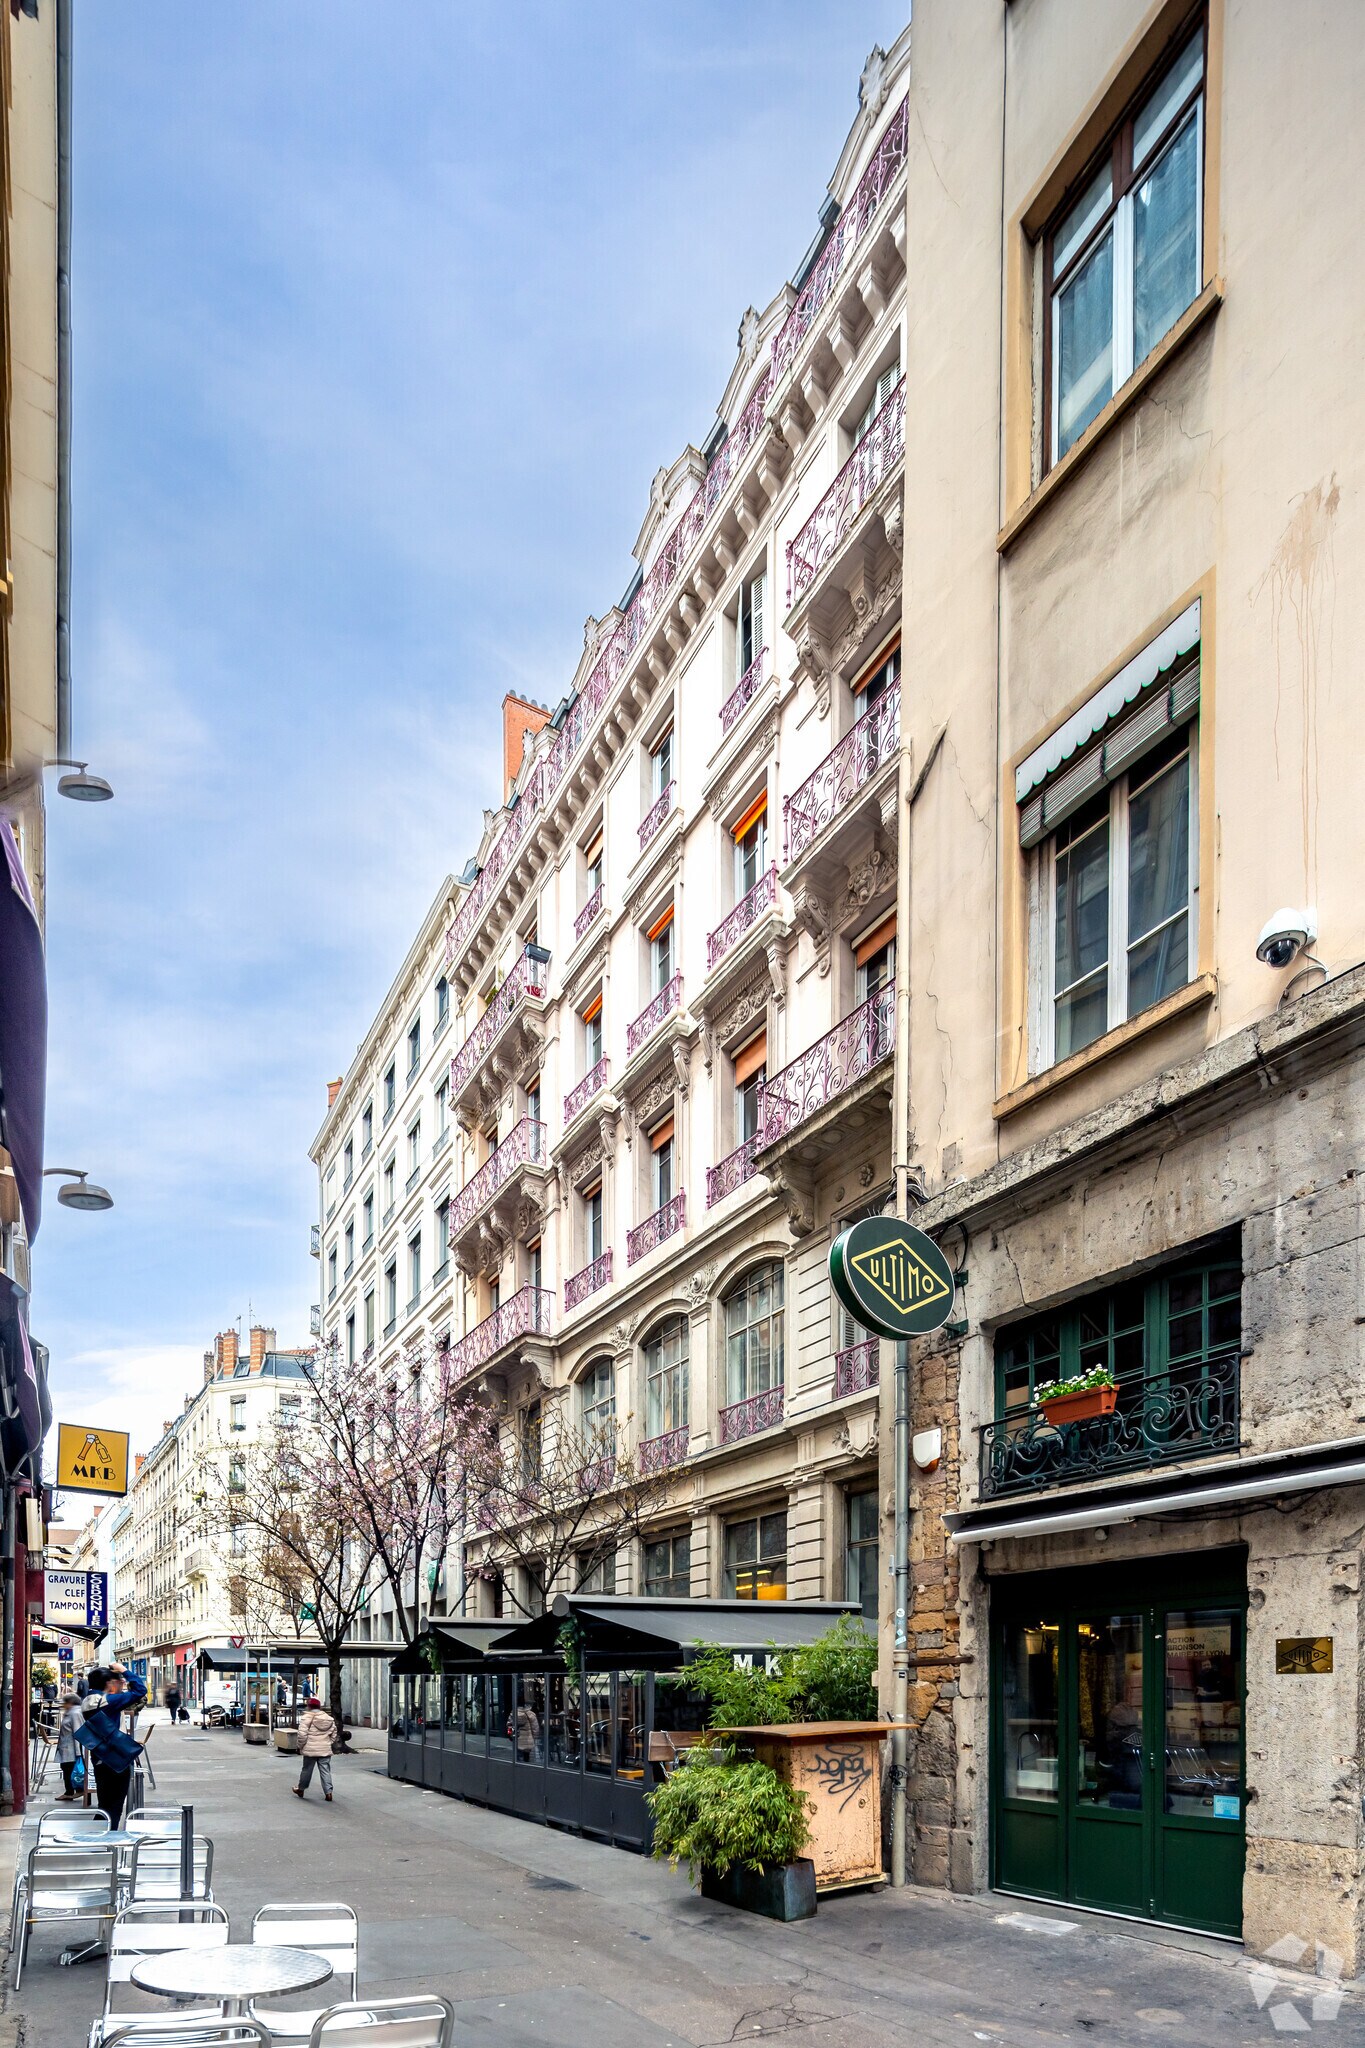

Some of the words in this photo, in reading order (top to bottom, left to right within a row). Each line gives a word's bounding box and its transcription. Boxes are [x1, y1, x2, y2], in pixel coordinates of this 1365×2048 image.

[70, 1463, 116, 1481] MKB
[48, 1575, 85, 1585] GRAVURE
[64, 1588, 85, 1598] CLEF
[90, 1573, 103, 1627] CORDONNIER
[49, 1601, 85, 1610] TAMPON
[1167, 1636, 1195, 1644] ACTION
[1167, 1643, 1205, 1651] BRONSON
[1167, 1650, 1192, 1658] MAIRE
